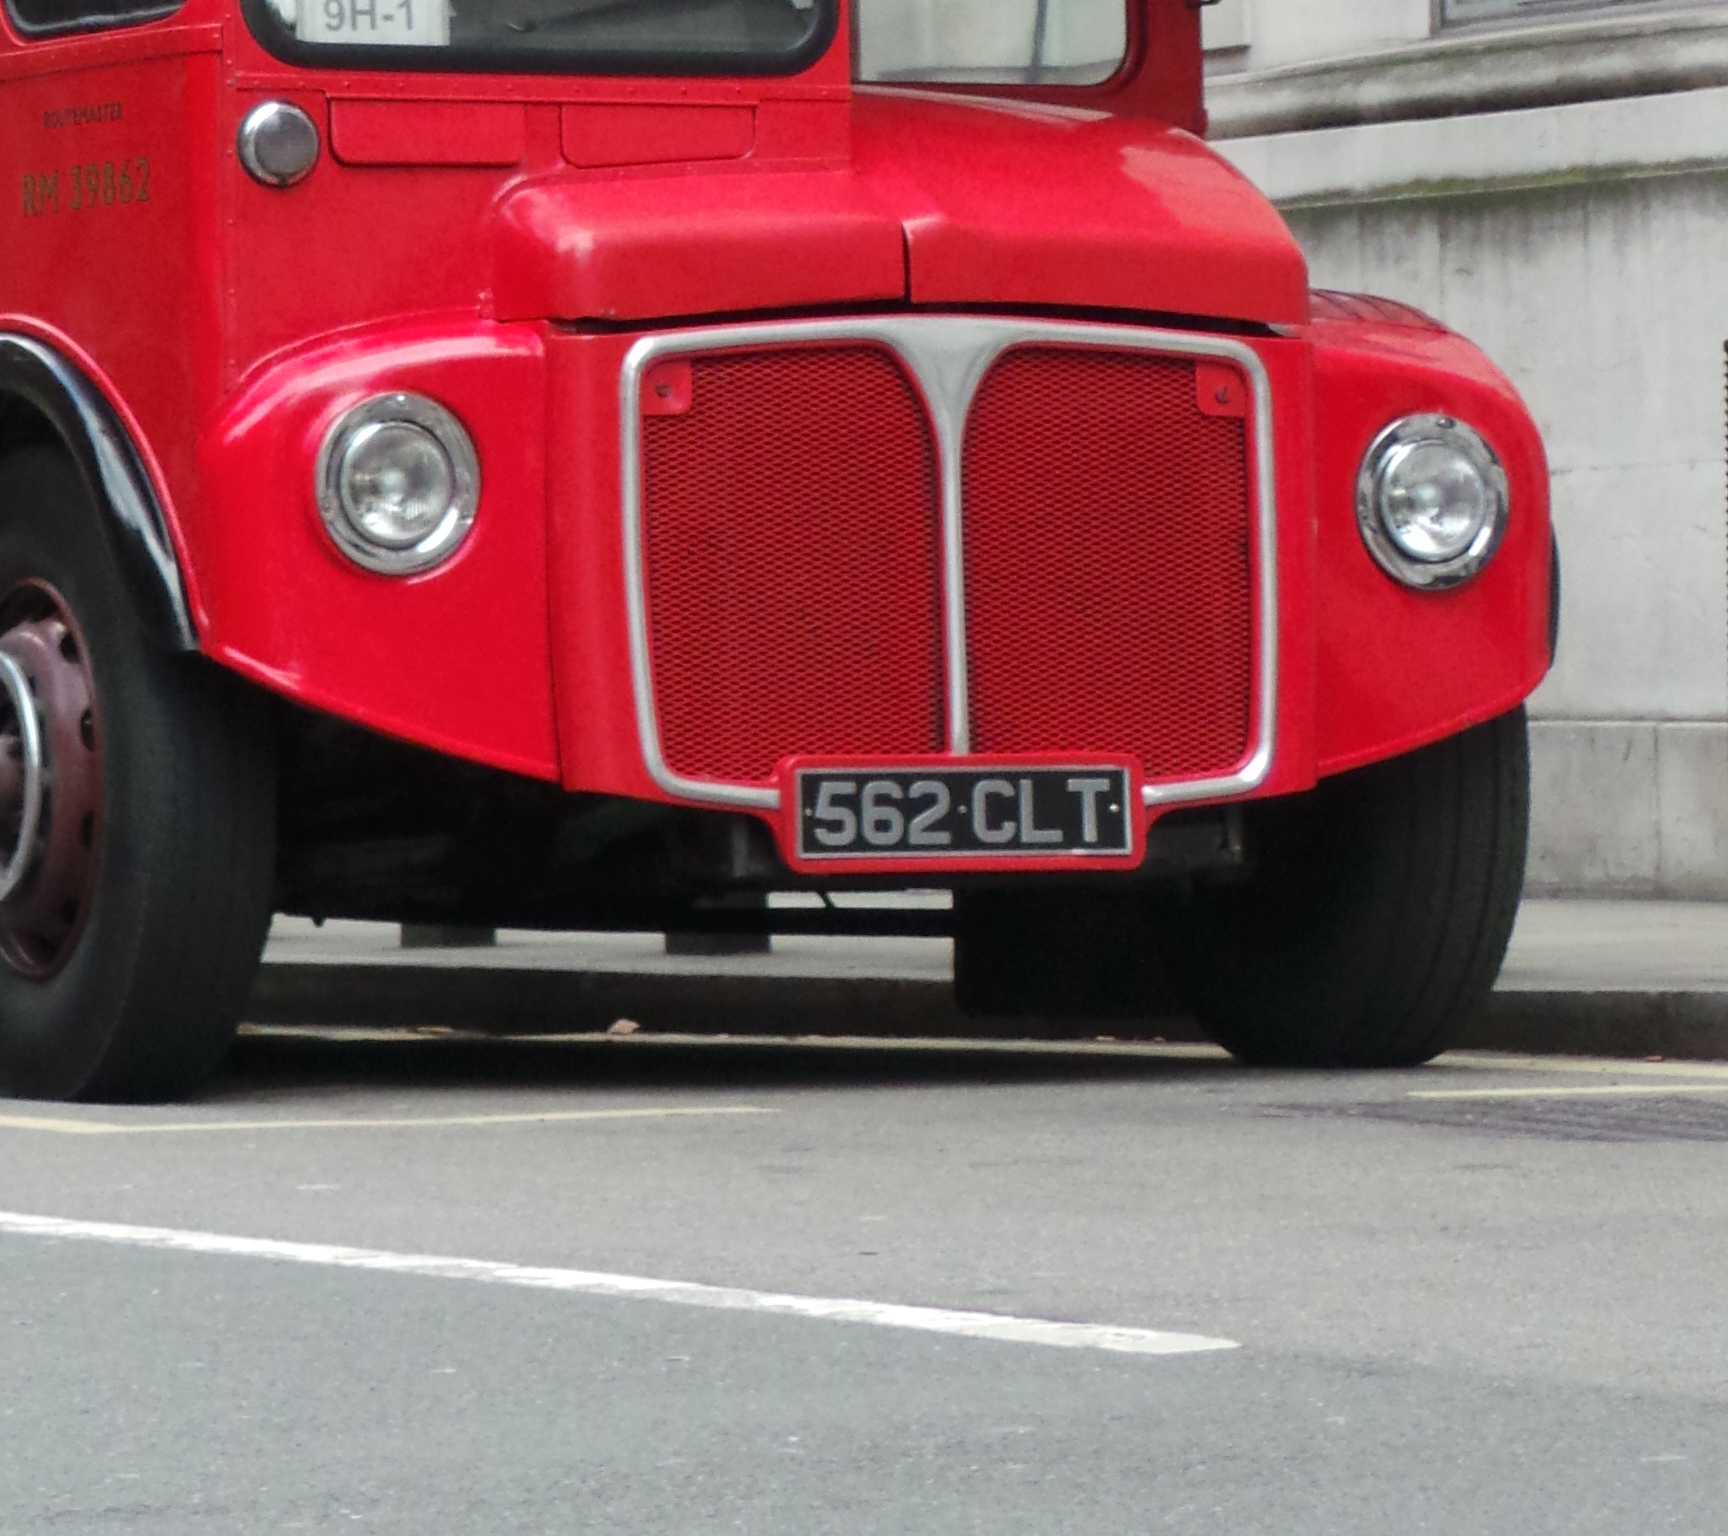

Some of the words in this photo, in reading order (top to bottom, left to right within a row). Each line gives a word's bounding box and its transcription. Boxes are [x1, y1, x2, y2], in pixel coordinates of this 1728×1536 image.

[22, 169, 60, 217] RM
[813, 780, 951, 847] 562
[971, 777, 1111, 845] CLT
